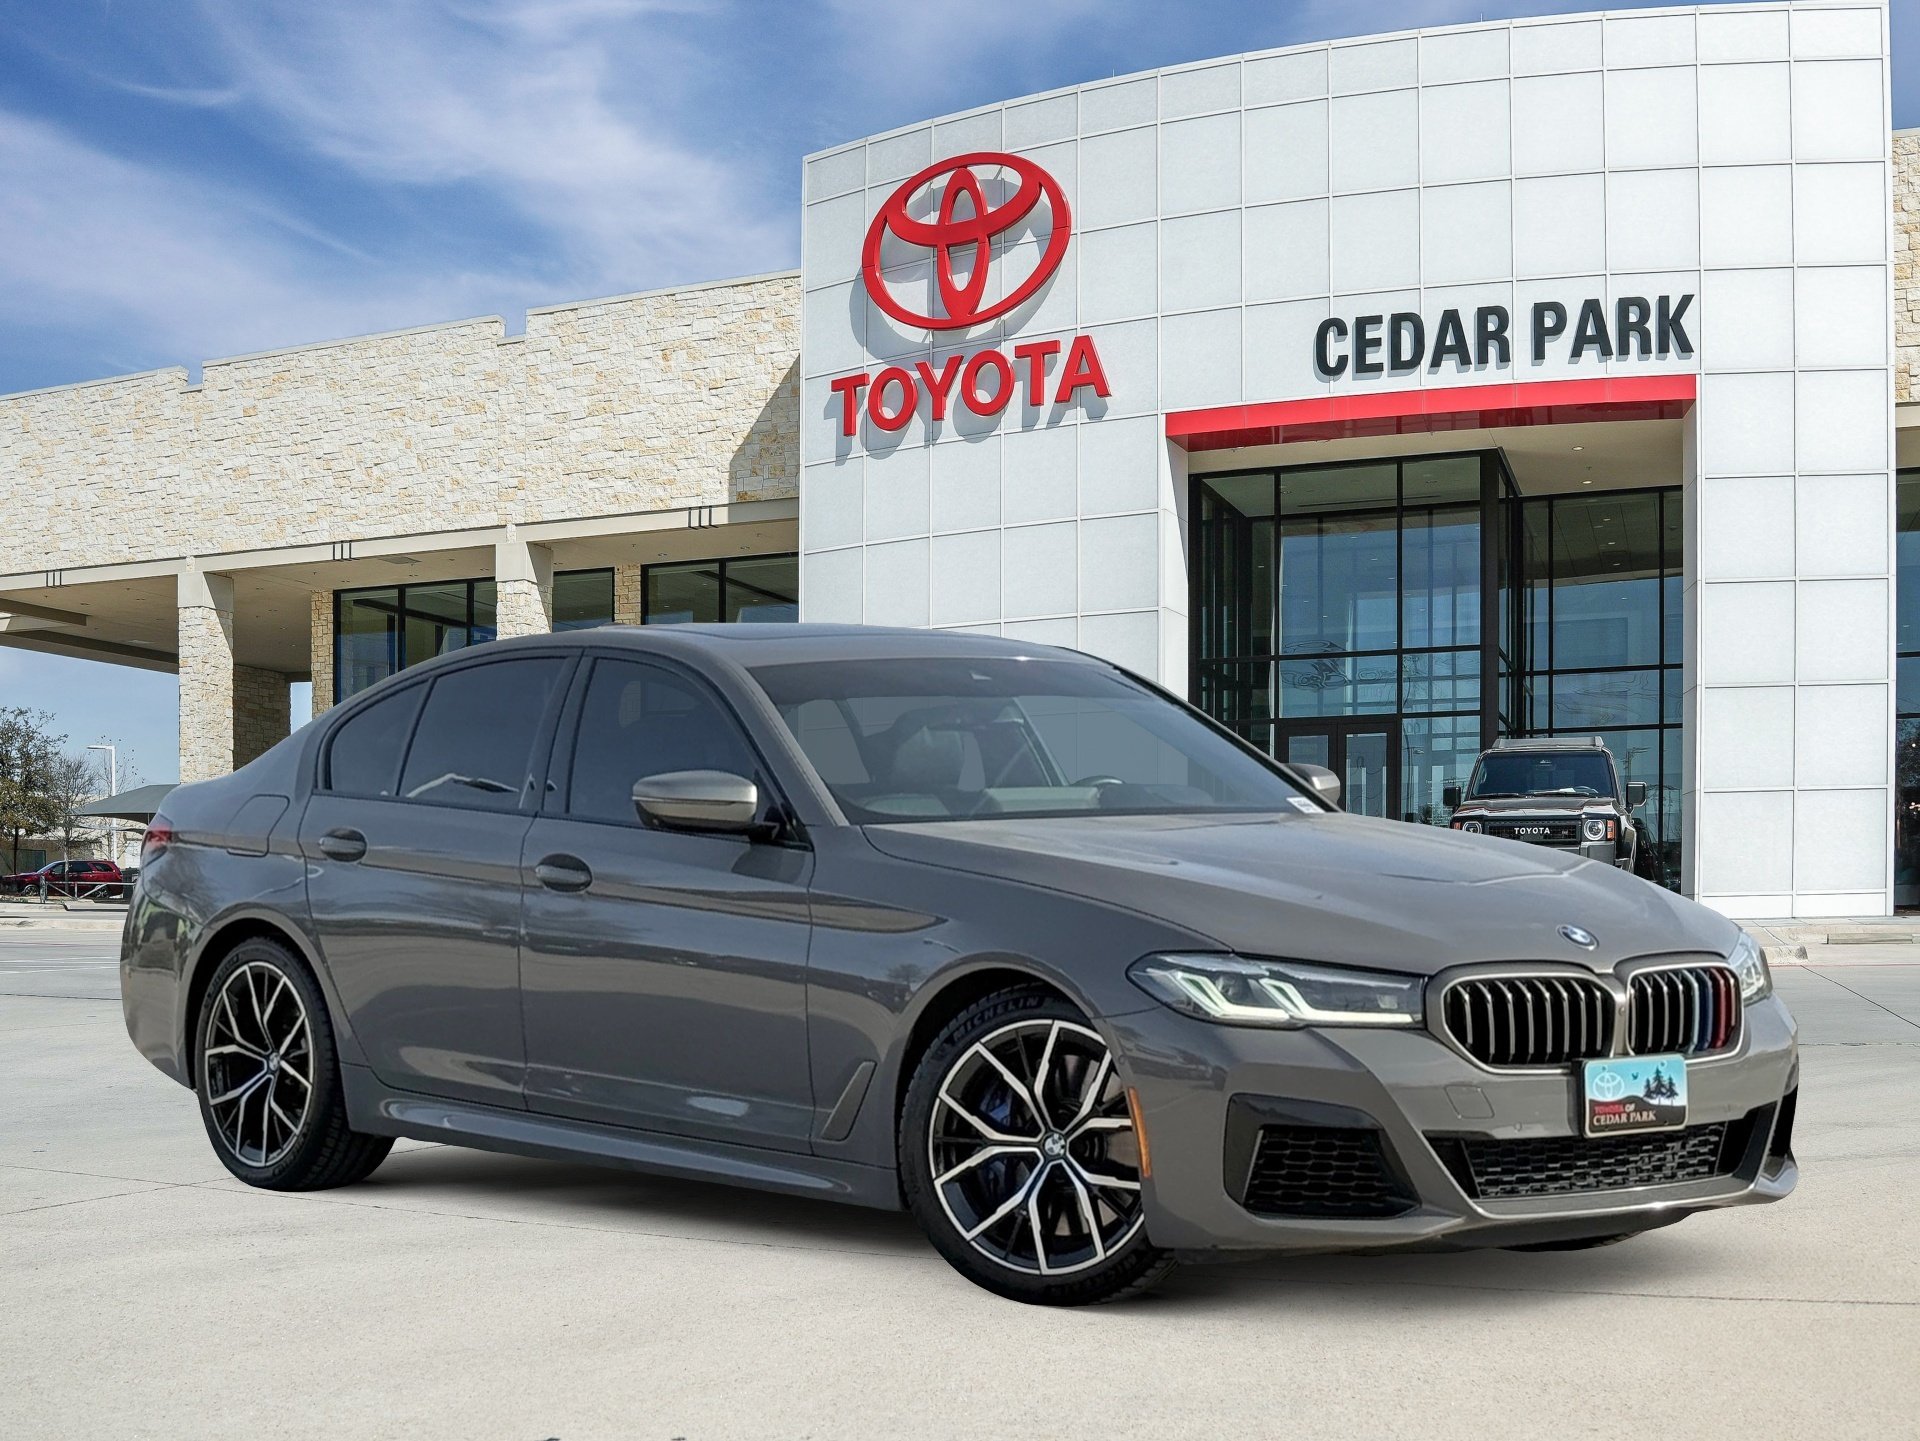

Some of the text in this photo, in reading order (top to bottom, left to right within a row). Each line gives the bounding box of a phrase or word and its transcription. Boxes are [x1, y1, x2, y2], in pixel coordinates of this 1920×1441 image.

[1315, 294, 1695, 377] CEDAR PARK
[831, 335, 1112, 437] TOYOTA
[1514, 827, 1551, 835] TOYOTA
[952, 996, 1040, 1043] MICHELIN
[1593, 1110, 1657, 1126] CEDAR PARK
